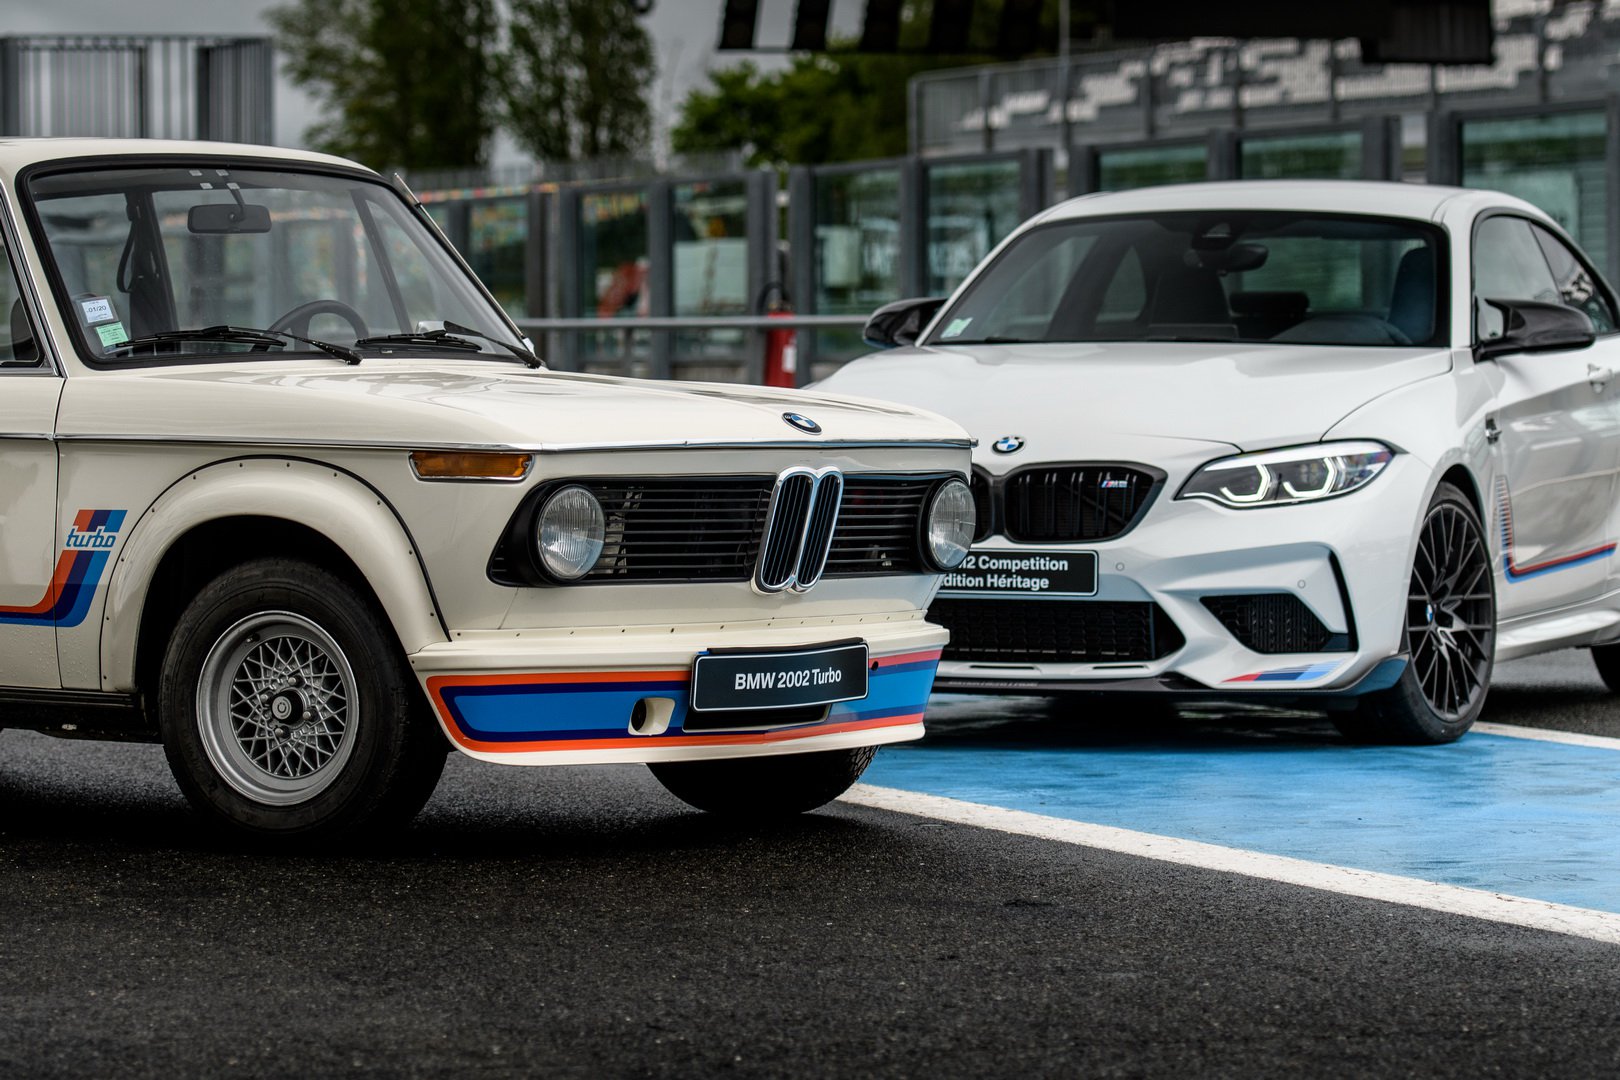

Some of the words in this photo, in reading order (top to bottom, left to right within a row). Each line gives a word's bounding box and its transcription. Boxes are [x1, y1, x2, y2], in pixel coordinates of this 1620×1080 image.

[65, 528, 117, 548] turbo
[978, 555, 1069, 573] Competition
[940, 573, 984, 588] dition
[986, 573, 1050, 591] Héritage
[734, 672, 776, 690] BMW
[777, 670, 810, 688] 2002
[811, 666, 842, 685] Turbo
